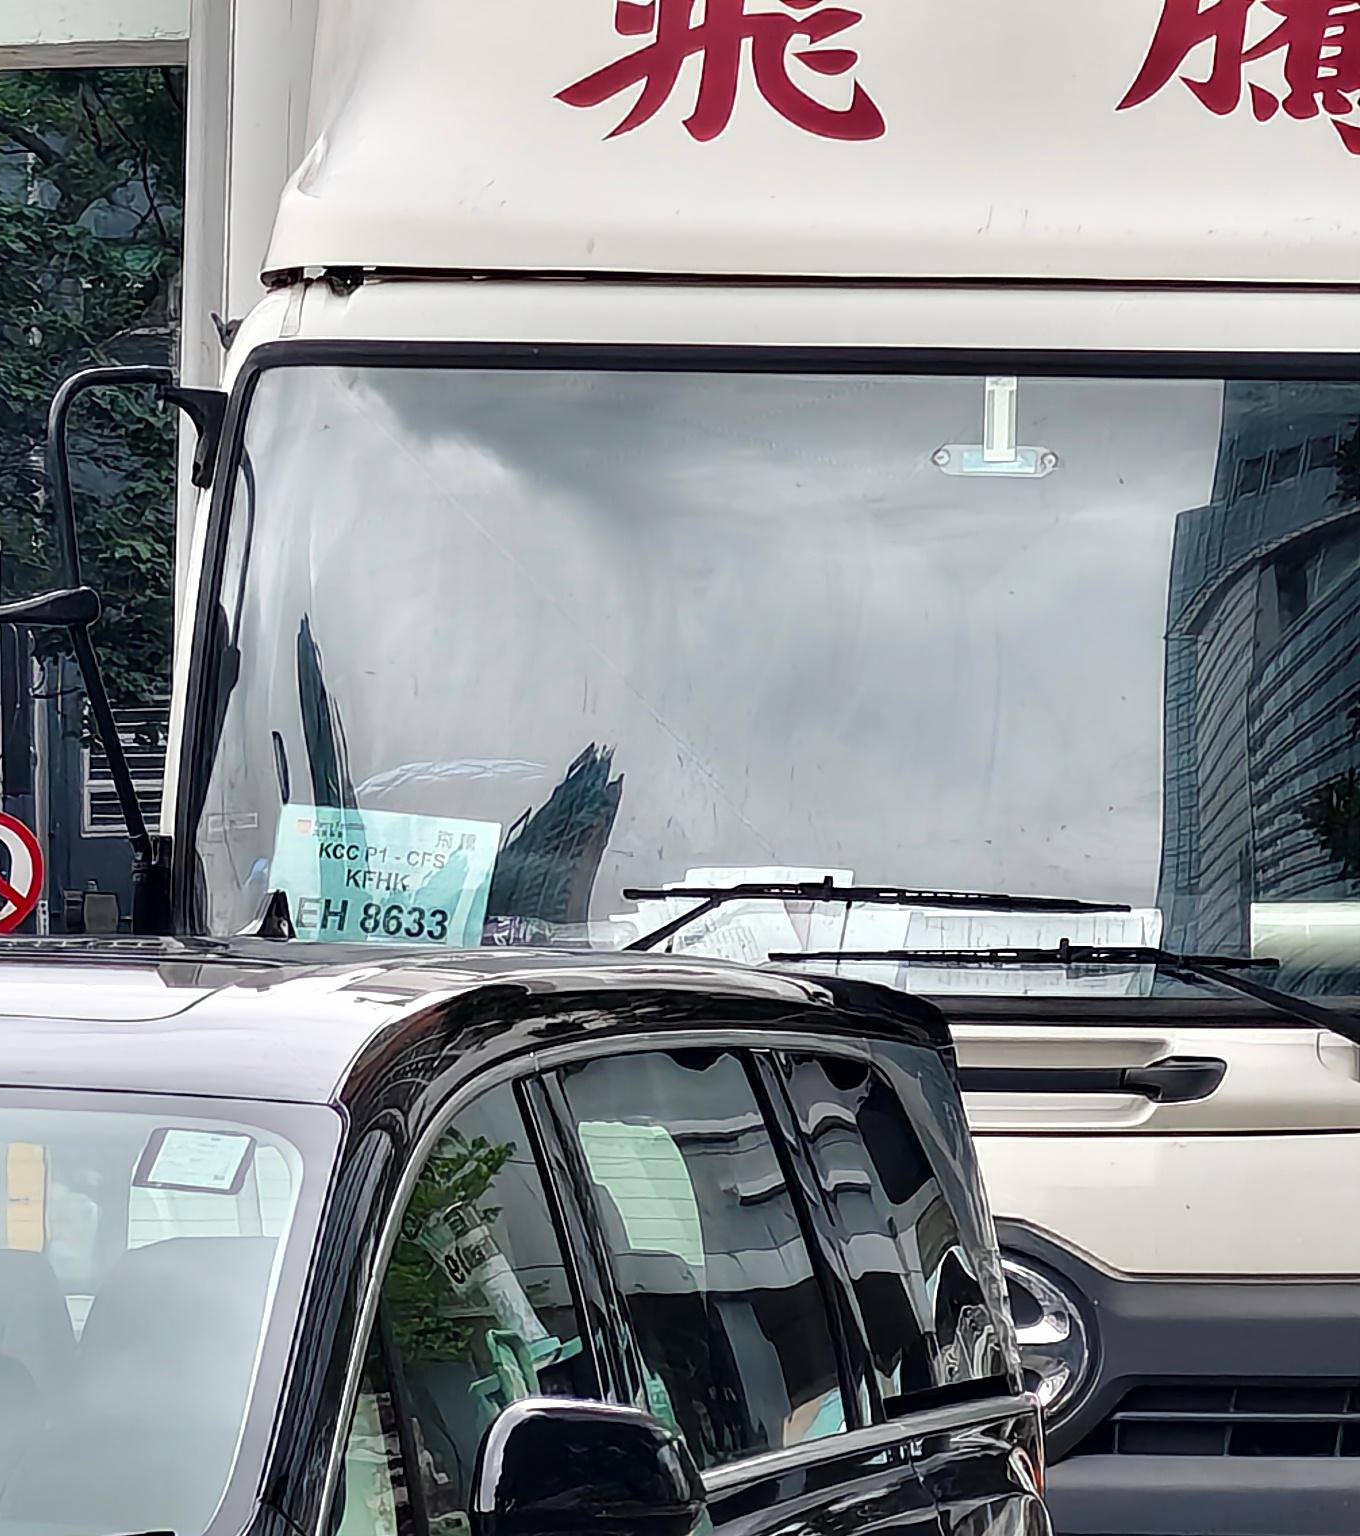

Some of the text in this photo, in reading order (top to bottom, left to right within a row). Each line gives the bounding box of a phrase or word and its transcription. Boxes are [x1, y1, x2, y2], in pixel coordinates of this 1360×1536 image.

[318, 842, 360, 861] KCC
[364, 846, 387, 864] P1
[406, 850, 446, 869] CFS
[345, 868, 411, 893] KFHK
[296, 896, 449, 941] EH 8633
